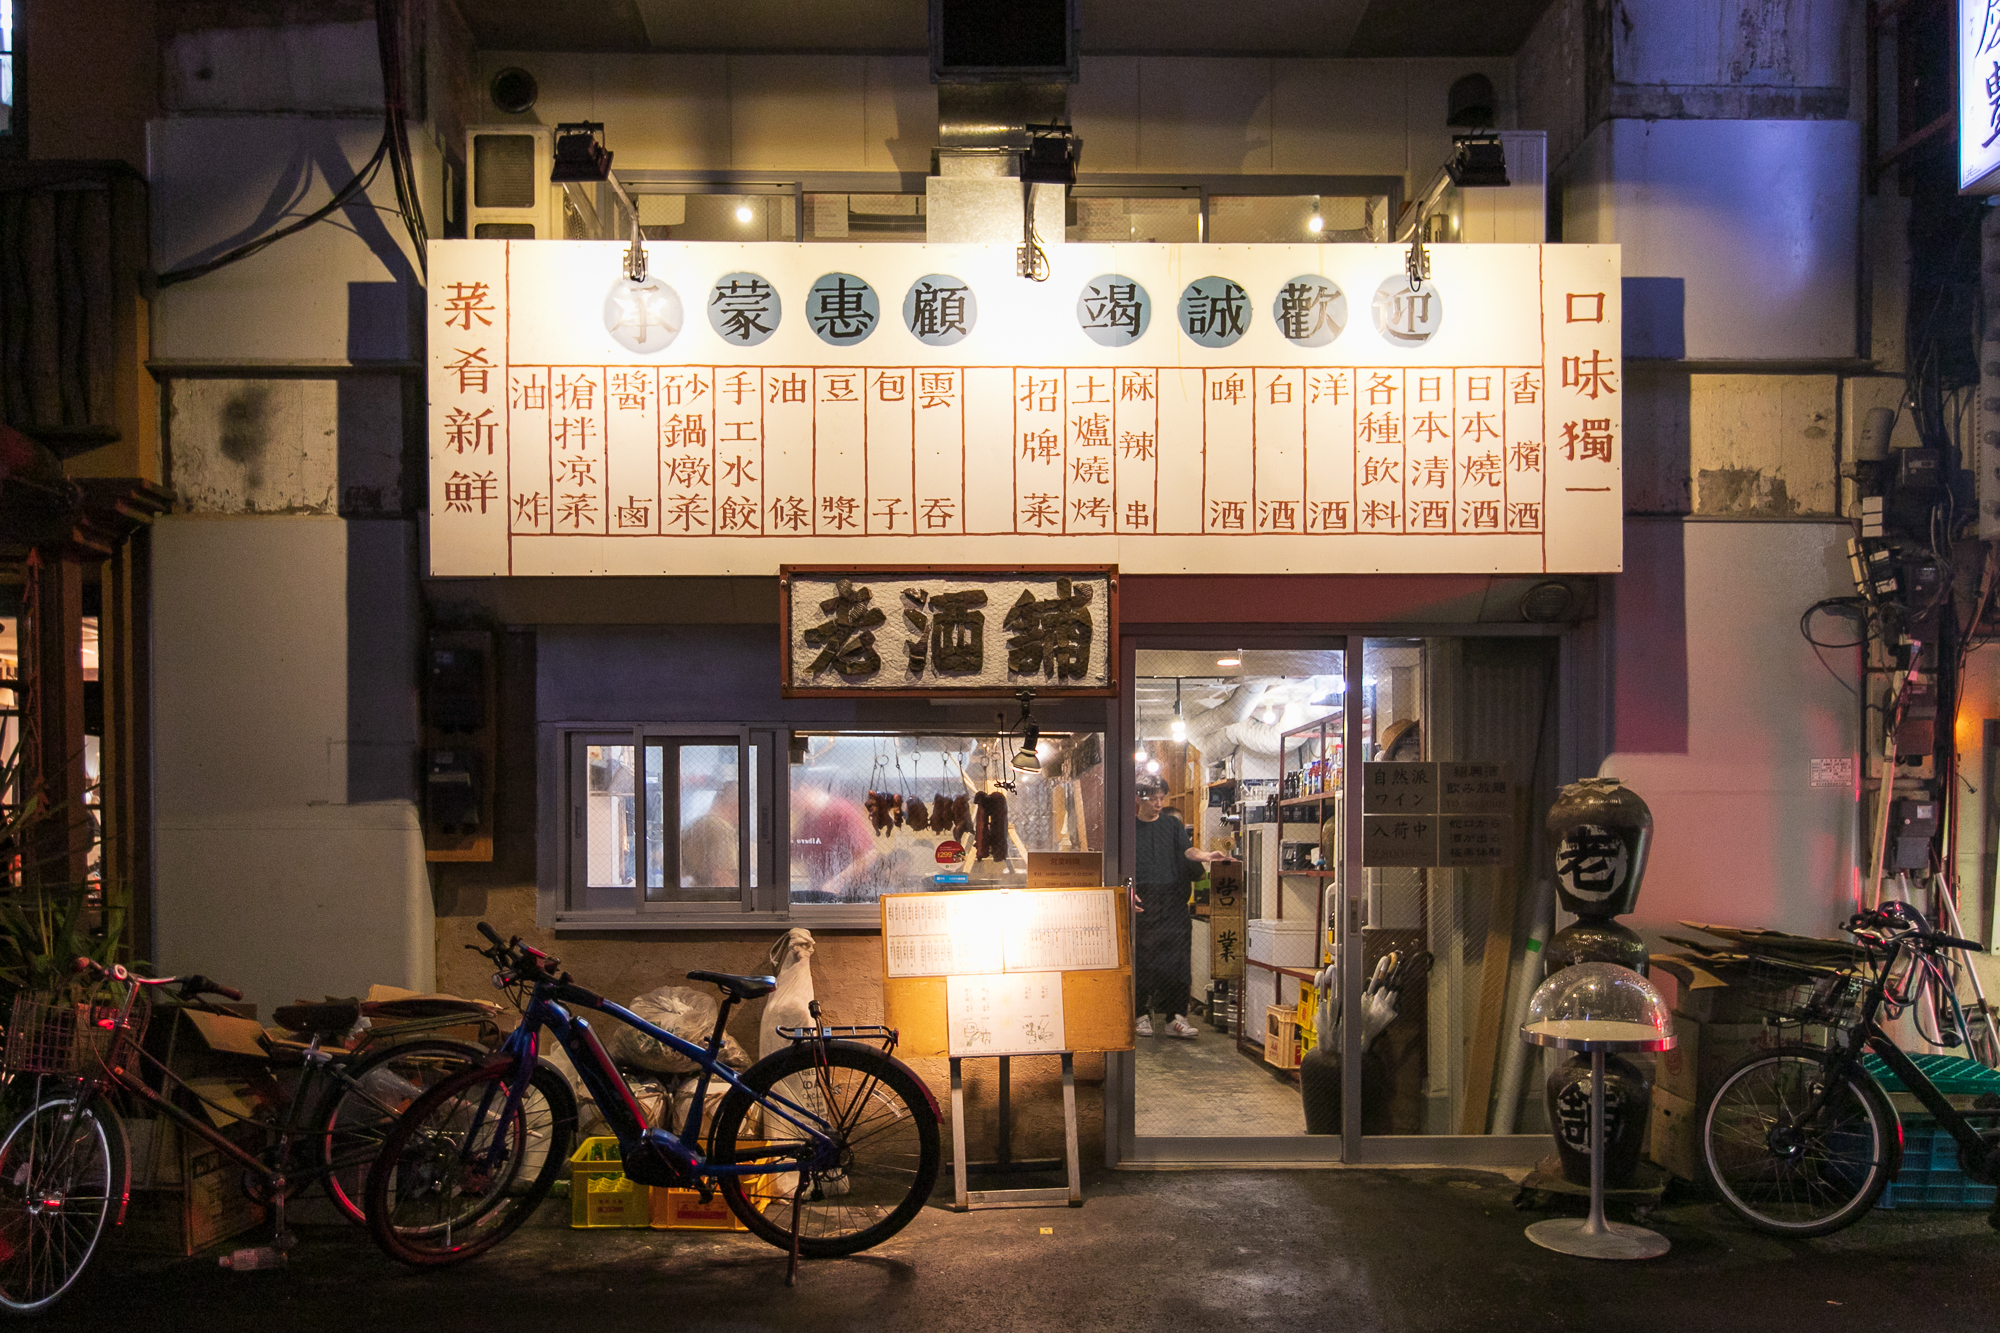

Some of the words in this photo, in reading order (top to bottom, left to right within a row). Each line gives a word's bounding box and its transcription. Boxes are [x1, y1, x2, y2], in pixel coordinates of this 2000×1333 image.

[444, 282, 499, 514] 菜肴新鮮
[512, 373, 548, 529] 油炸
[718, 371, 759, 531] 手工水餃
[768, 372, 811, 531] 油條
[821, 374, 861, 530] 豆漿
[871, 371, 909, 530] 包子
[919, 371, 956, 529] 雲吞
[1020, 375, 1061, 528] 招牌菜
[1070, 375, 1112, 528] 土爐燒烤
[1119, 370, 1155, 529] 麻辣串
[1210, 373, 1248, 530] 啤酒
[1258, 374, 1300, 530] 白酒
[1309, 373, 1350, 530] 洋酒
[1357, 371, 1402, 529] 各種飲料
[1410, 376, 1451, 529] 日本清酒
[1459, 376, 1503, 529] 日本燒酒
[1508, 371, 1541, 529] 香檳酒
[1558, 292, 1617, 492] 口味獨一
[1372, 821, 1427, 840] 入荷中
[1374, 768, 1429, 786] 自然派
[1375, 793, 1424, 807] ワイン
[1446, 782, 1506, 794] 飲み放題
[1216, 877, 1238, 963] 営業
[1558, 826, 1619, 892] 老
